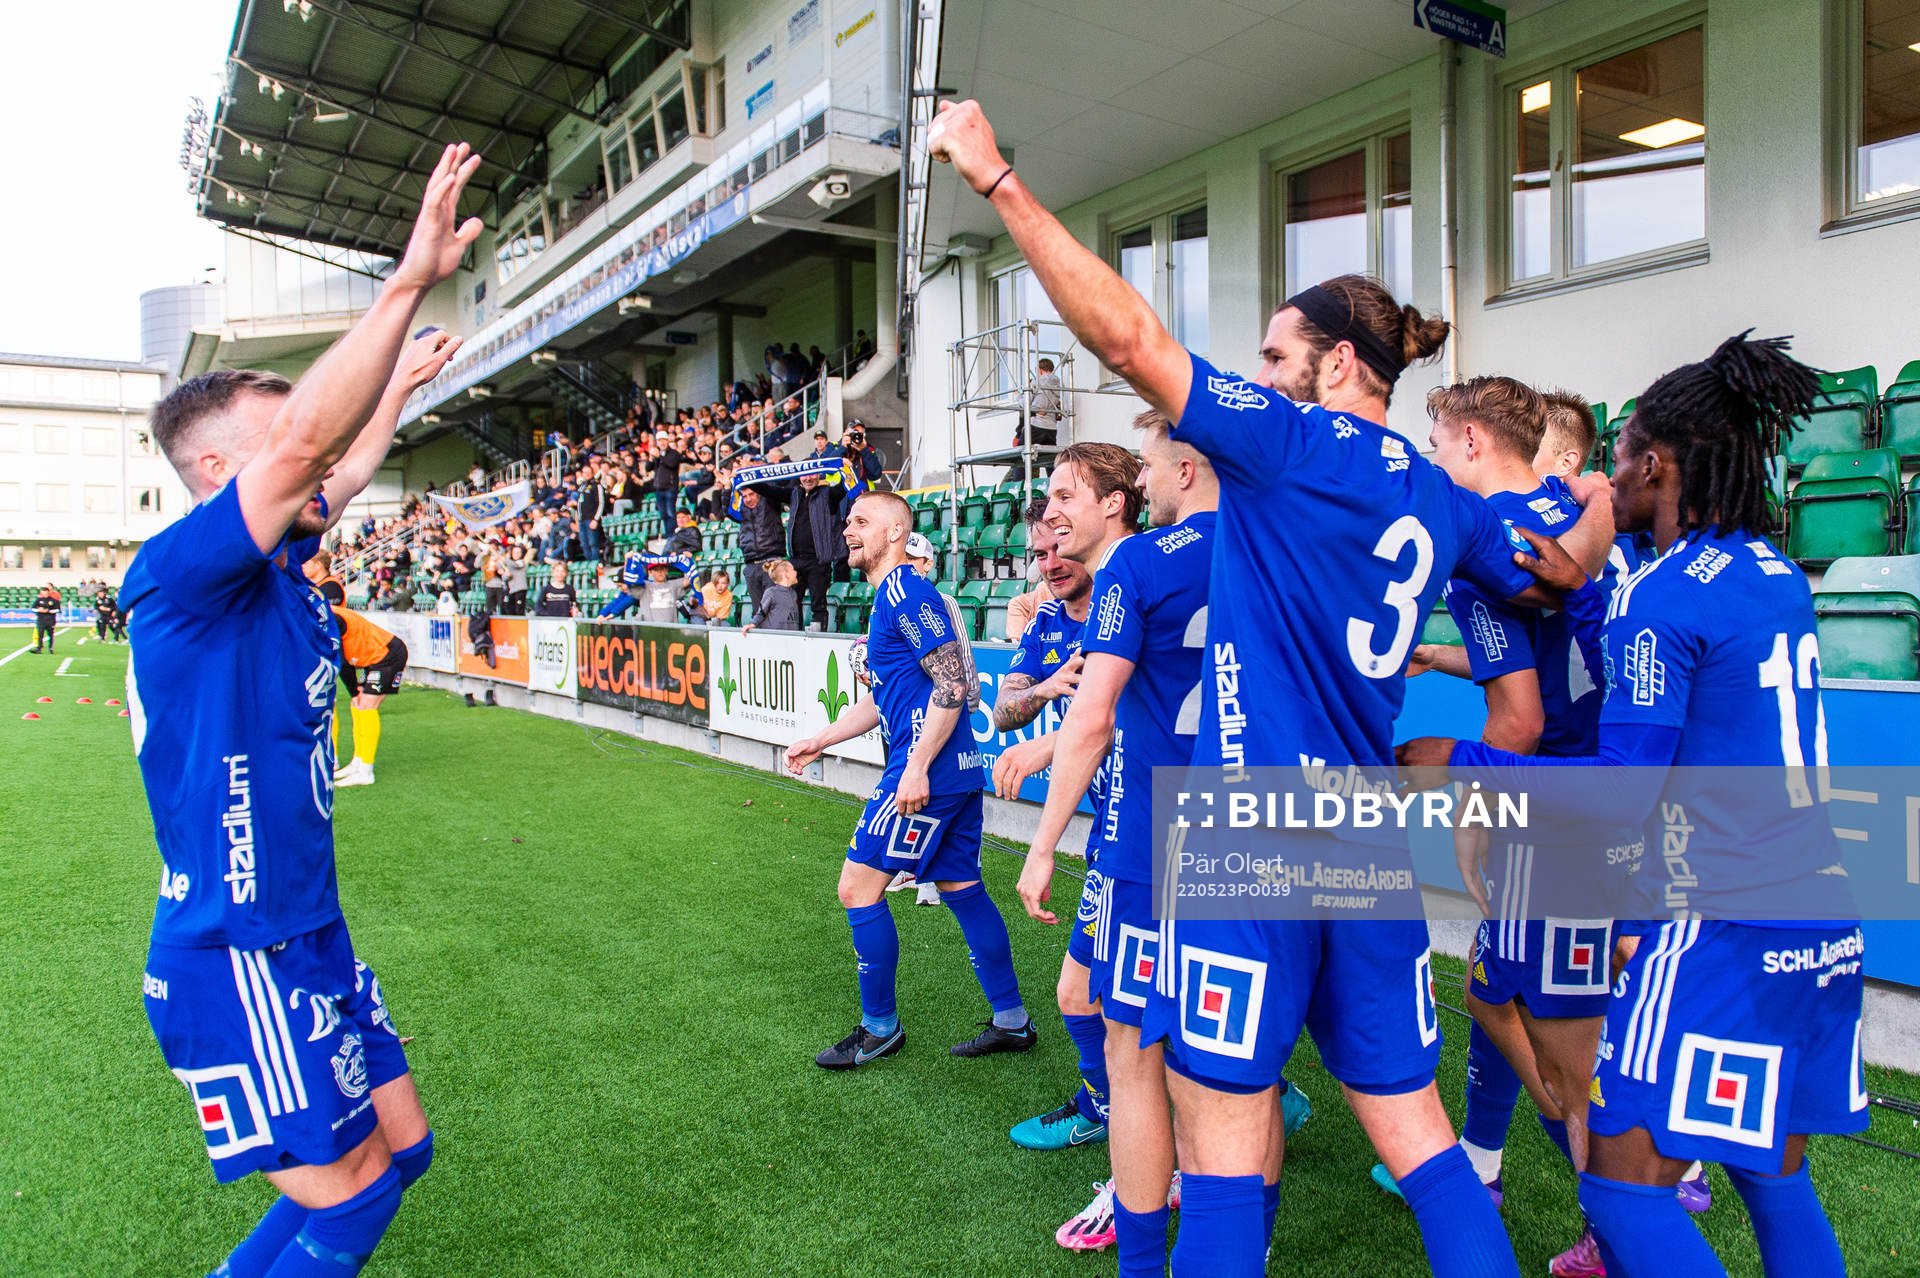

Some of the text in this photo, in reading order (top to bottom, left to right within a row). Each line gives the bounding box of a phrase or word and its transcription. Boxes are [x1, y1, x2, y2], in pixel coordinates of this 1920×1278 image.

[1452, 14, 1465, 25] RAD
[1457, 25, 1471, 36] RAD
[1489, 20, 1505, 49] A
[1346, 514, 1434, 679] 3
[1477, 610, 1497, 657] SUNDFRAKT
[738, 657, 795, 713] LILIUM
[1638, 640, 1651, 700] SUNDFRAKT
[741, 711, 796, 729] FASTIGHETER
[1214, 642, 1251, 784] stadium
[1104, 728, 1124, 842] stadium
[222, 754, 256, 904] stadium
[1256, 861, 1413, 891] SCHLÄGERGÅRDEN
